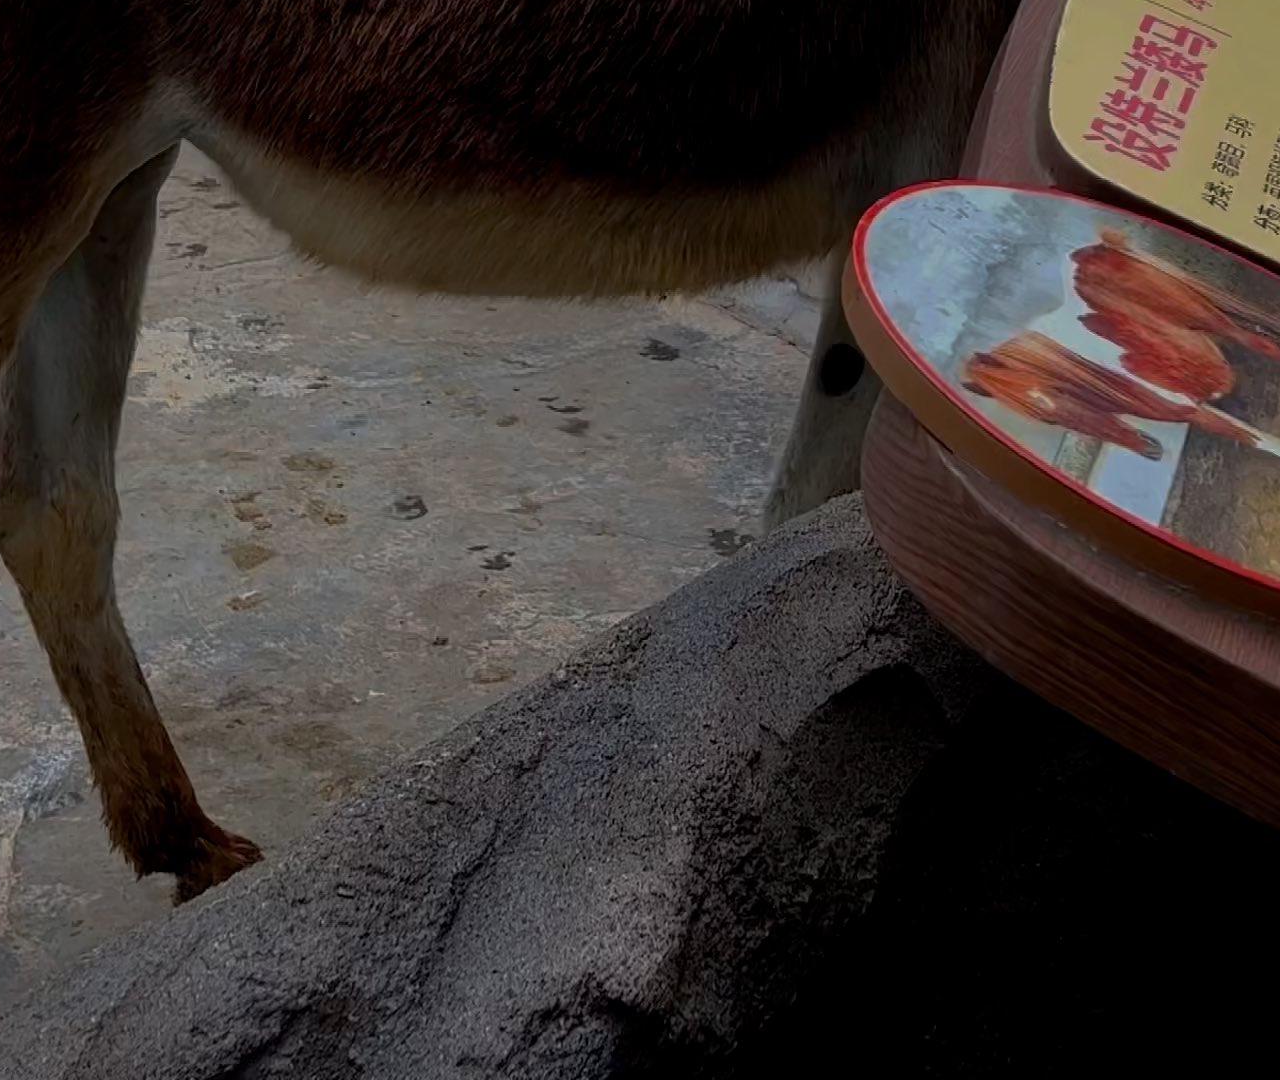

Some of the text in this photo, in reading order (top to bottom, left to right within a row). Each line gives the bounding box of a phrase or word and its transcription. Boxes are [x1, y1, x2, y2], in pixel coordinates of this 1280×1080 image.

[1085, 16, 1215, 169] 设特兰矮马
